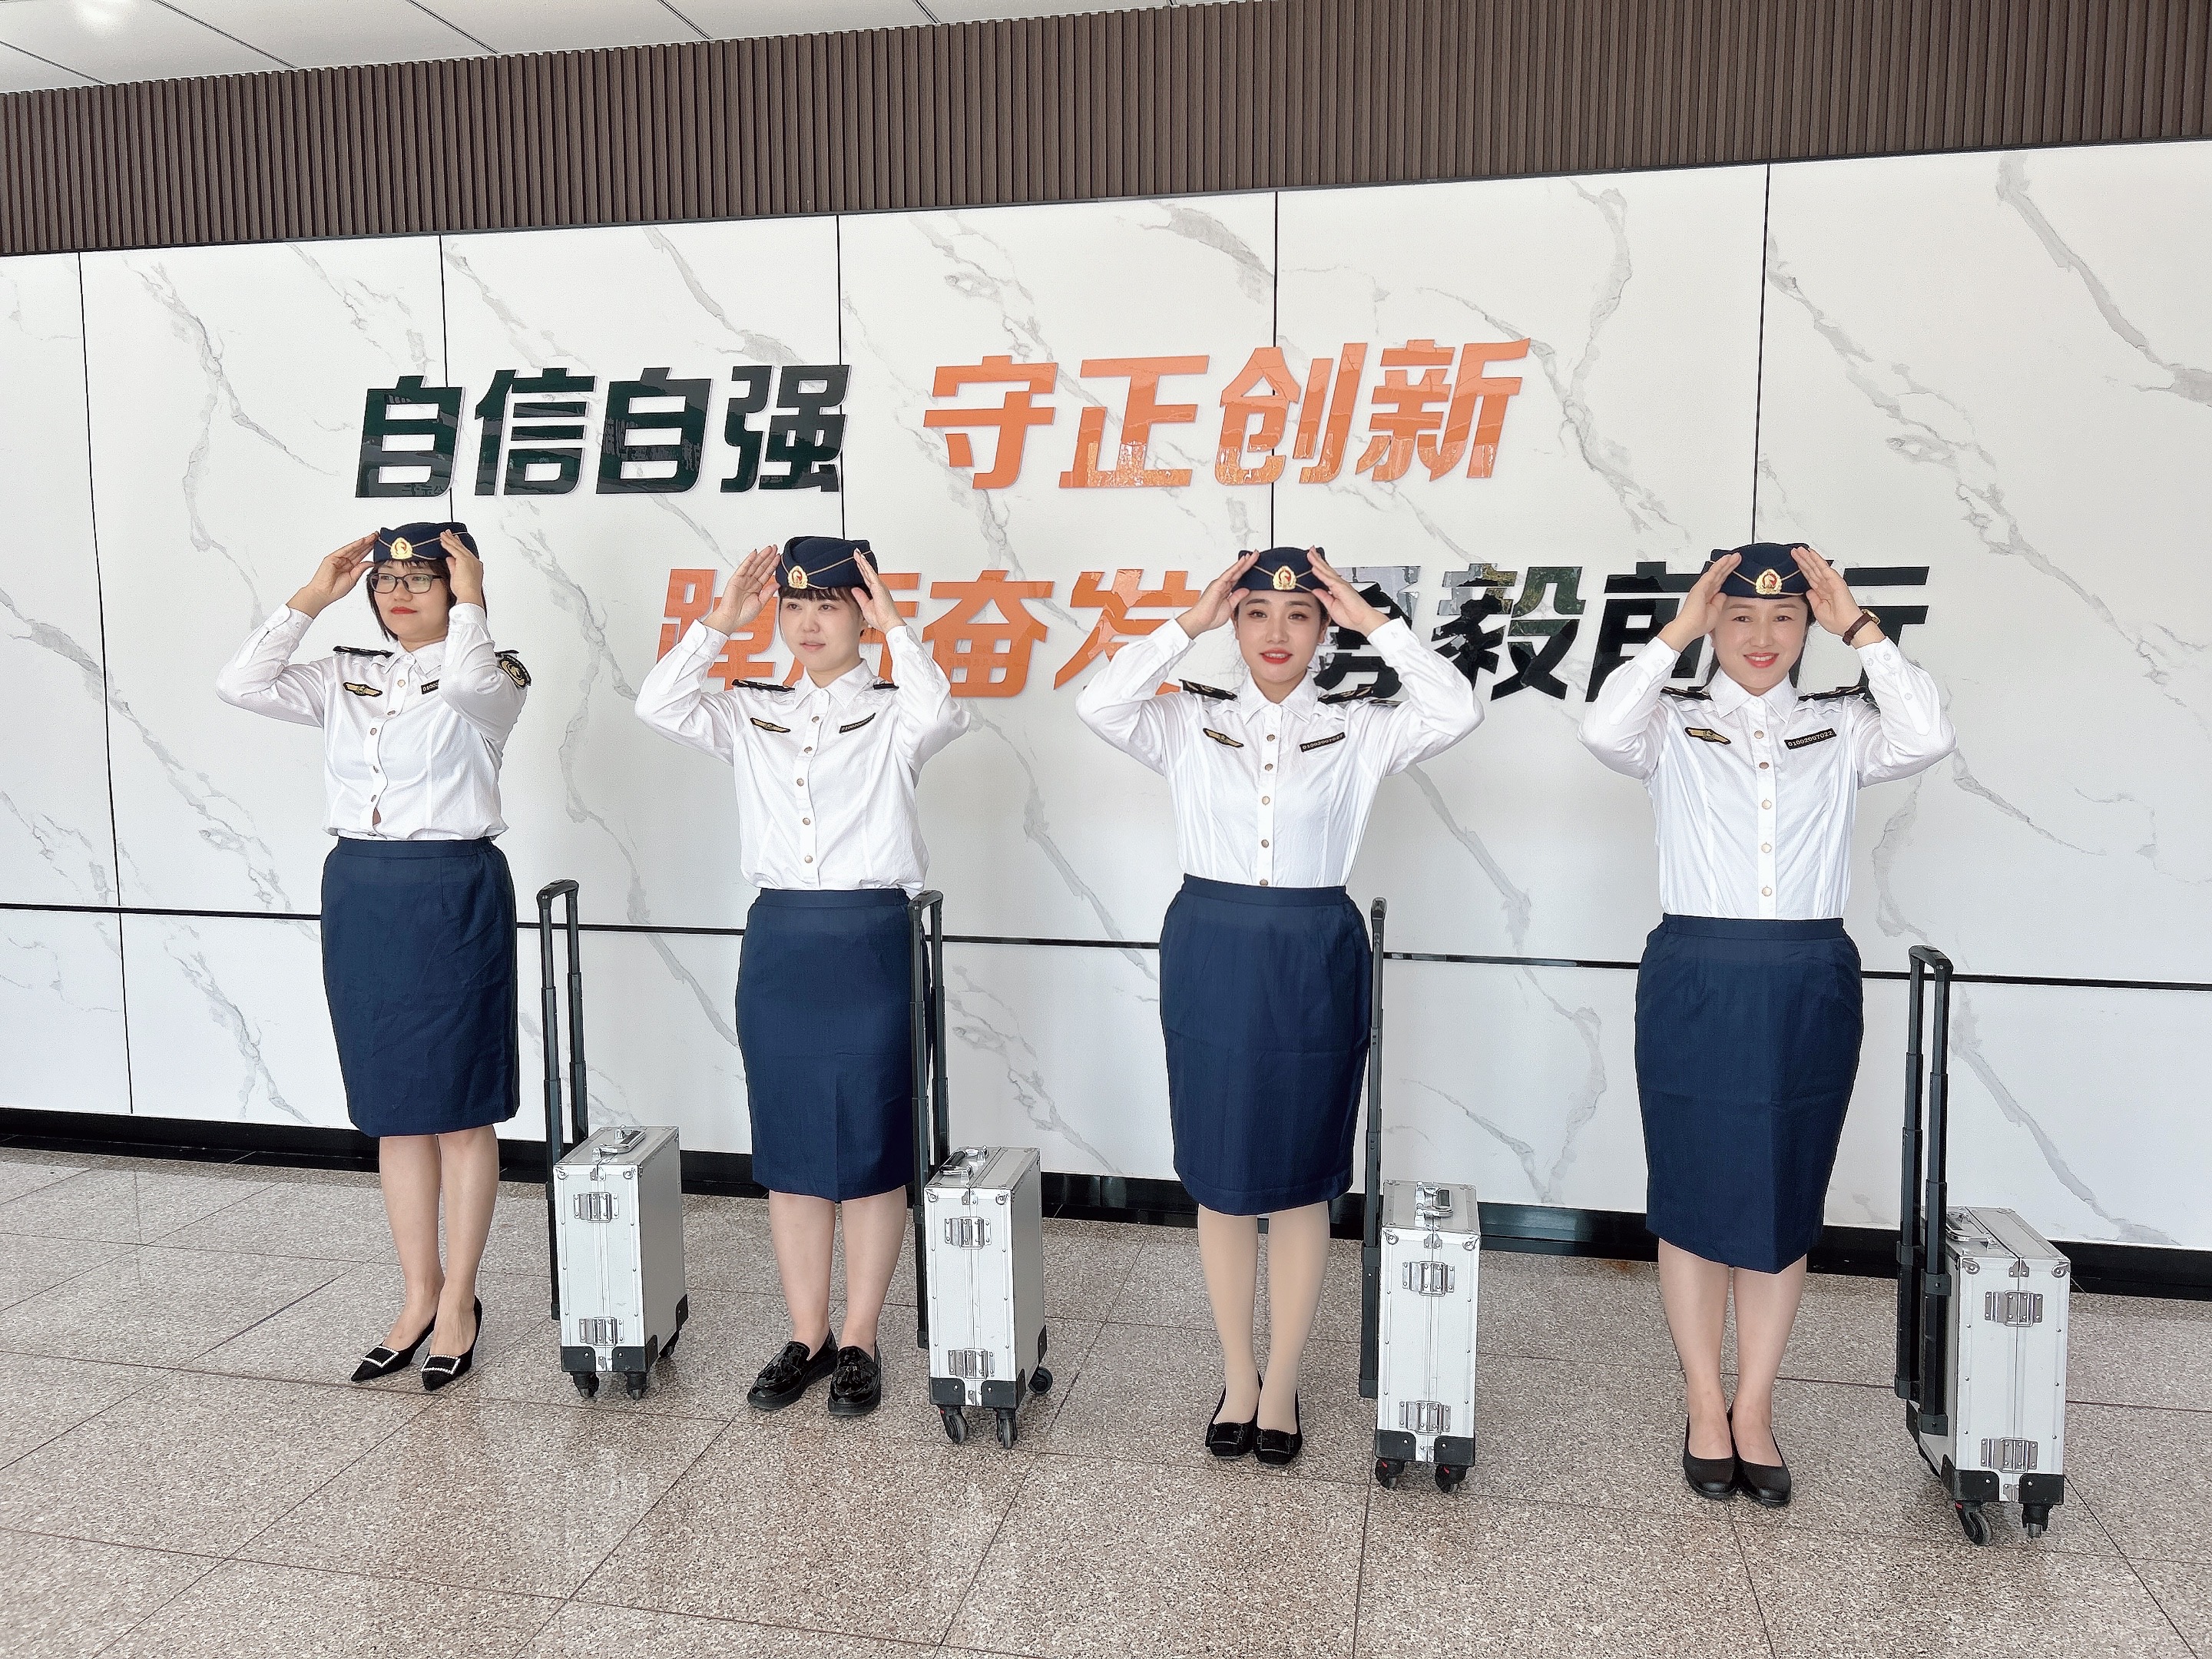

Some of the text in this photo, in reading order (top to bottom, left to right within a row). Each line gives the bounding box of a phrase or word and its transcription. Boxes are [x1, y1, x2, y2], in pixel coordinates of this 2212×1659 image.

[356, 338, 1531, 498] 自信自强 守正创新
[1787, 730, 1833, 747] 01002007022
